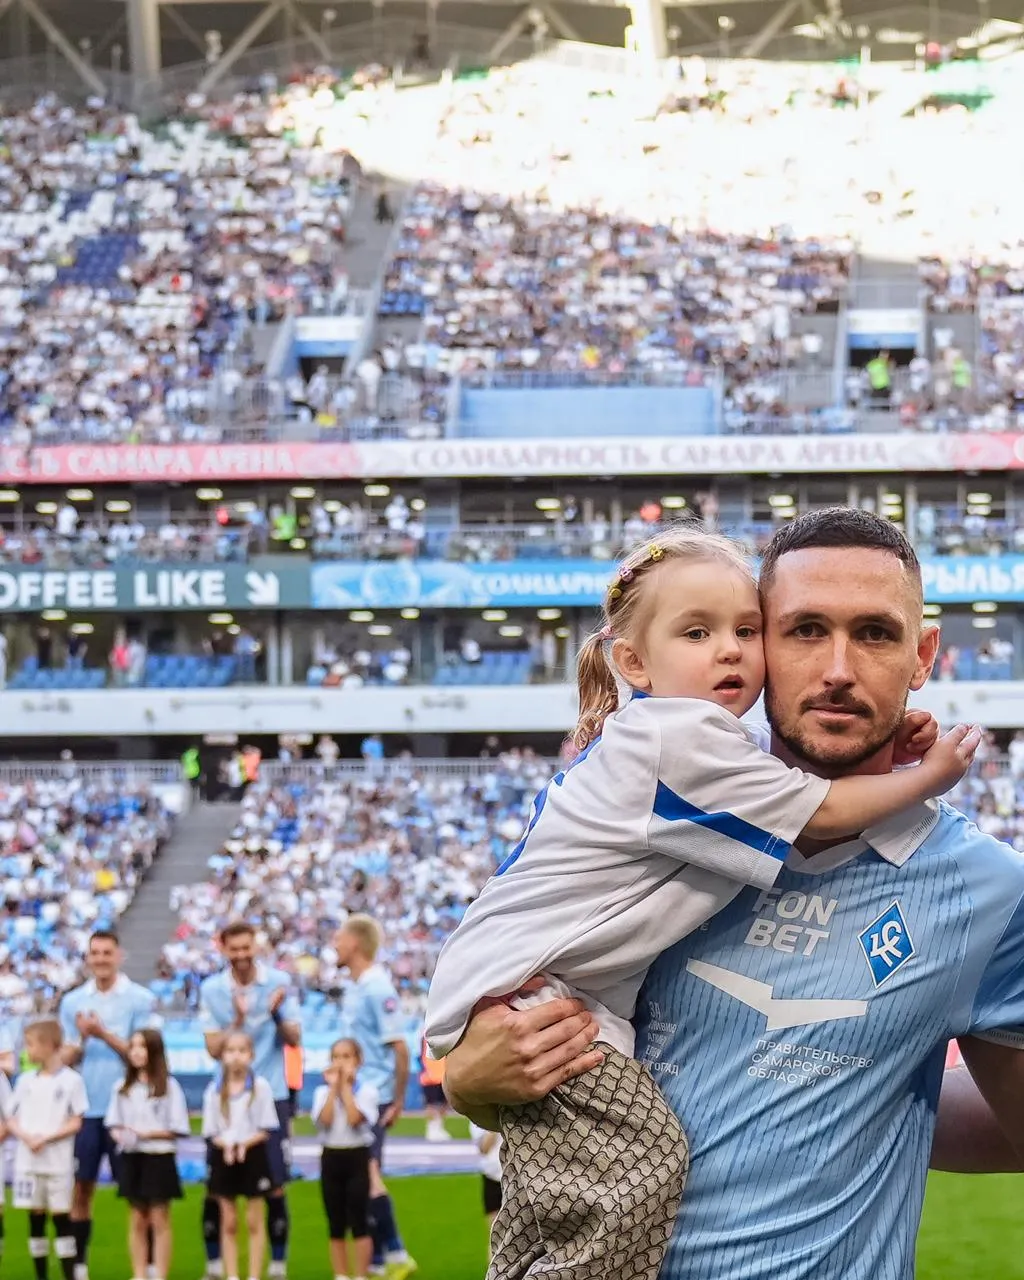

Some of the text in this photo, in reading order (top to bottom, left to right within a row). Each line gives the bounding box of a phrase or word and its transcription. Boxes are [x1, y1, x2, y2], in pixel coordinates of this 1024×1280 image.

[411, 441, 888, 469] СОЛИДАРНОСТЬ САМАРА АРЕНА
[0, 570, 227, 607] OFFEE LIKE
[752, 888, 838, 926] FON
[744, 918, 830, 957] BET
[751, 1053, 842, 1078] САМАРСКОЙ
[755, 1039, 874, 1068] ПРАВИТЕЛЬСТВО
[747, 1066, 818, 1088] ОБЛАСТИ
